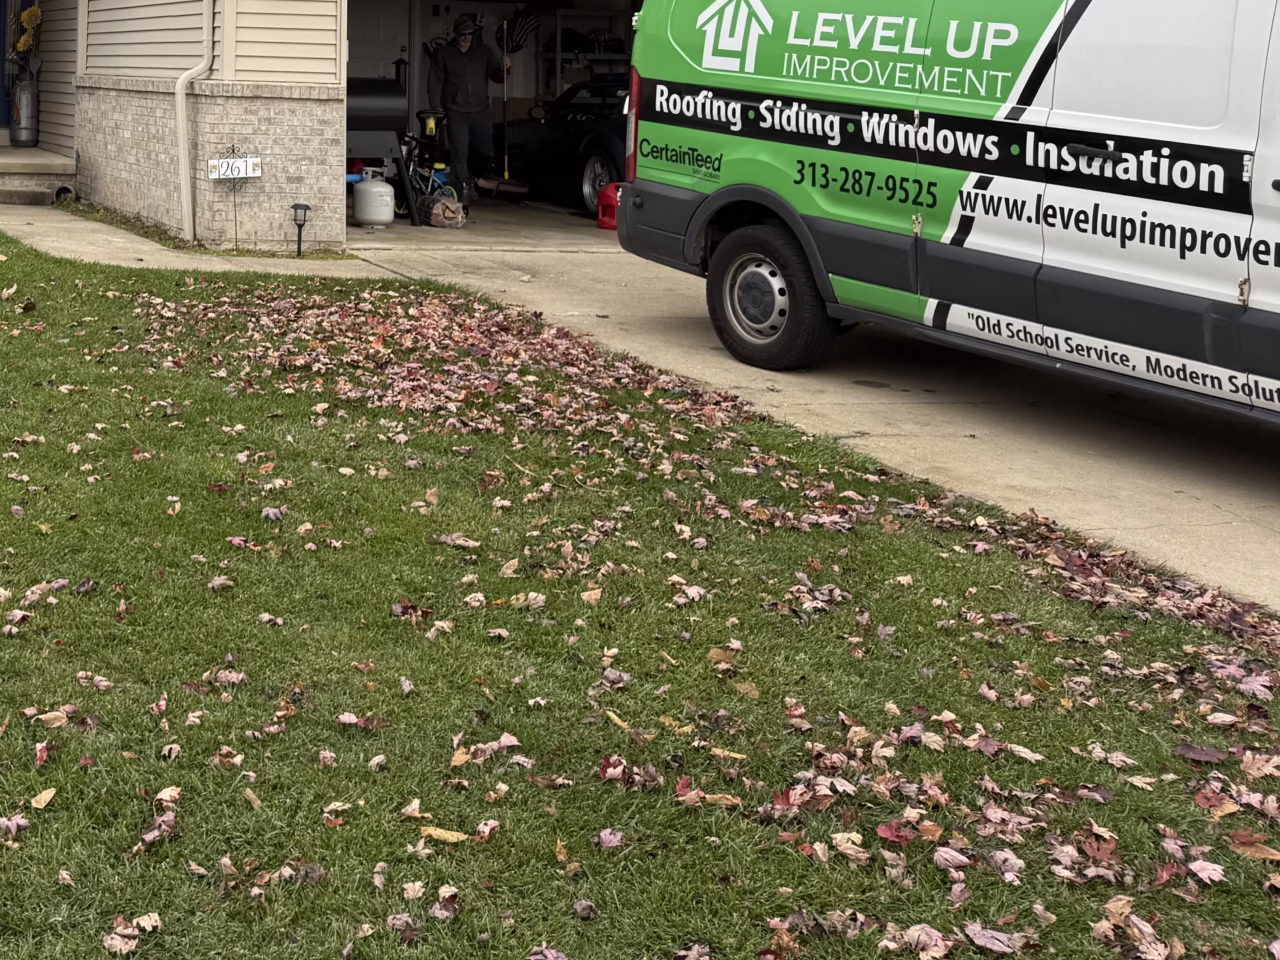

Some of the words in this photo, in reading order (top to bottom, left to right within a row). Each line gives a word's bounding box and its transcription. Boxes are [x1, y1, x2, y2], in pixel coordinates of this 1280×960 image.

[786, 10, 932, 57] LEVEL
[945, 20, 1019, 61] UP
[782, 52, 1012, 98] IMPROVEMENT
[655, 84, 742, 132] Roofing
[759, 99, 841, 146] Siding
[861, 111, 1000, 161] Windows
[220, 160, 248, 177] 261
[639, 137, 723, 173] CertainTeed
[793, 159, 938, 209] 313-287-9525
[967, 312, 1002, 337] "Old
[1005, 322, 1061, 352] School
[1064, 337, 1137, 372] Service,
[1146, 355, 1223, 391] Modern
